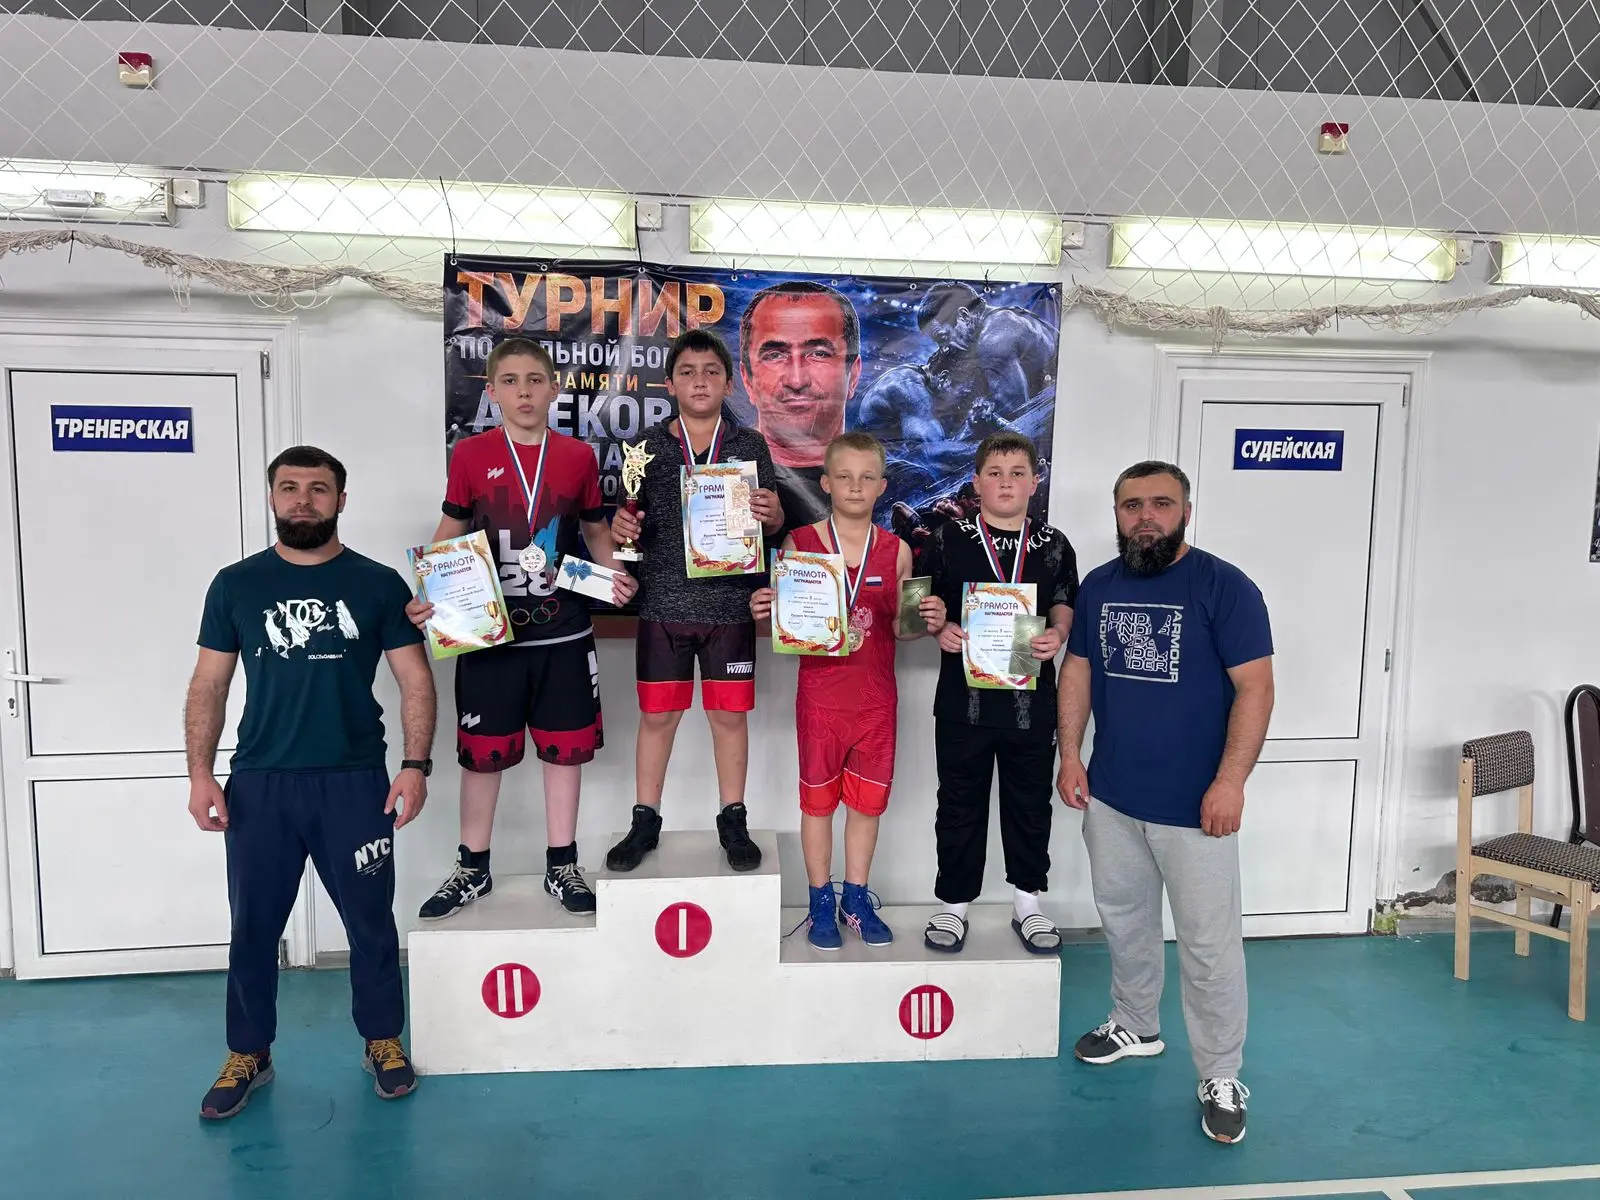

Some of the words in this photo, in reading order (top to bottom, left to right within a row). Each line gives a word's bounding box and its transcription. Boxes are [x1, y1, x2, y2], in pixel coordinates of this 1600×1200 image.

[456, 271, 725, 338] ТУРНИР
[55, 418, 189, 439] ТРЕНЕРСКАЯ
[1241, 436, 1336, 462] СУДЕЙСКАЯ
[433, 555, 476, 573] ГРАМОТА
[789, 569, 827, 579] ГРАМОТА
[499, 563, 558, 597] 28
[979, 602, 1019, 610] ГРАМОТА
[1169, 610, 1183, 683] ARMOUR
[354, 837, 391, 870] NYC
